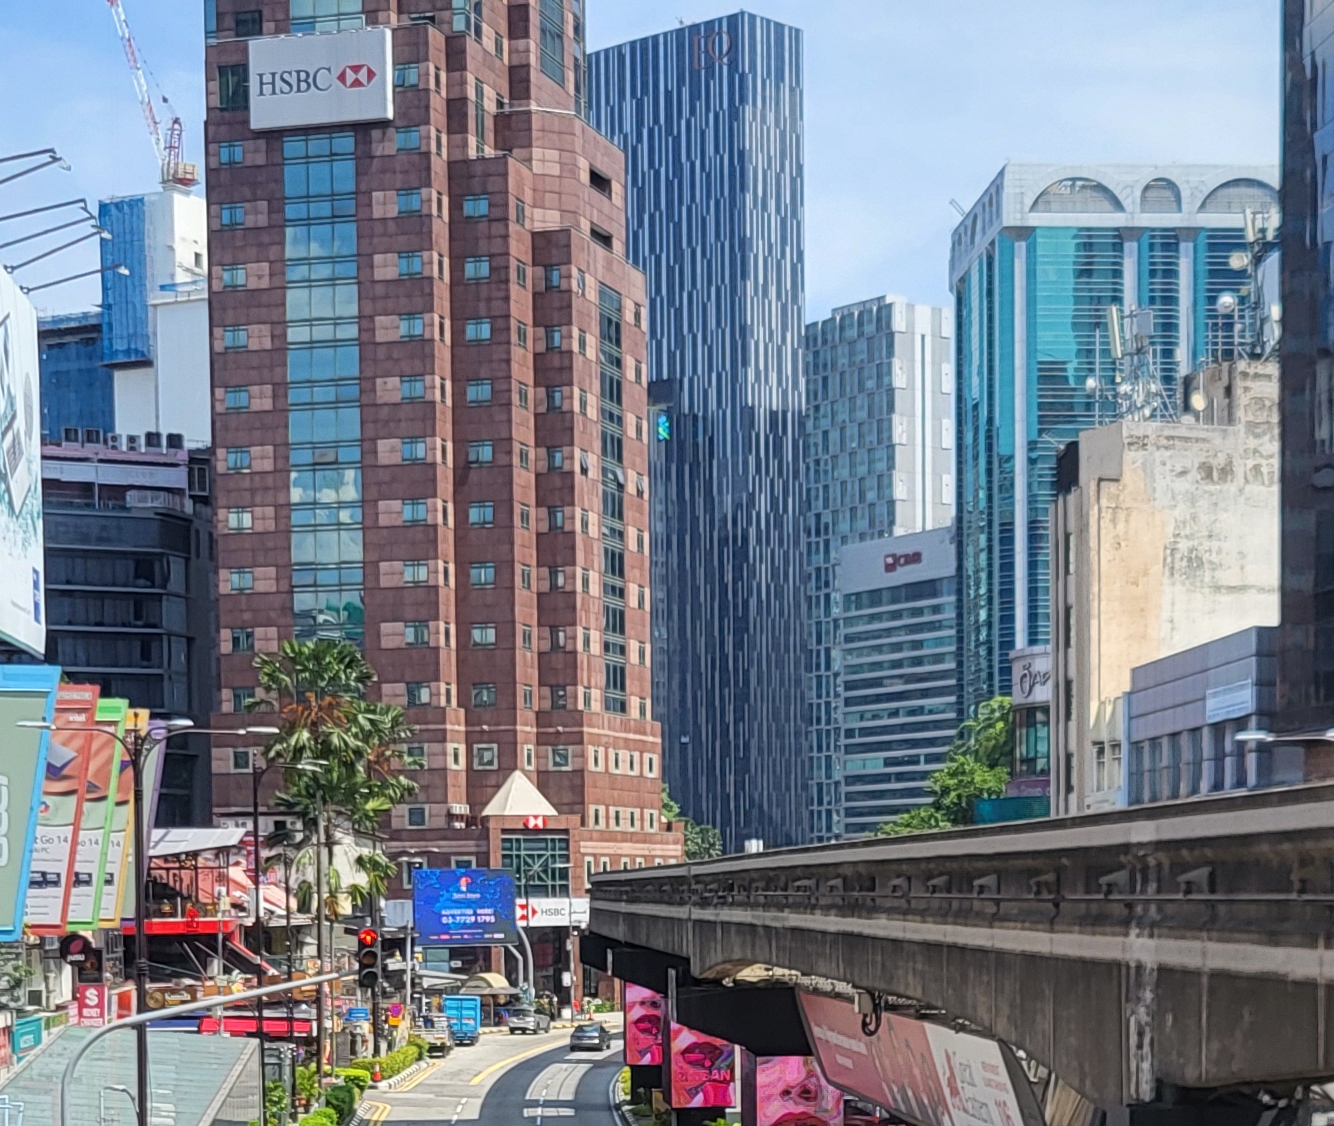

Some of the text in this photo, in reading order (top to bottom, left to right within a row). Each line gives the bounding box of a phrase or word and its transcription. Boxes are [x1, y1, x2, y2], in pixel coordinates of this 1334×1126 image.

[693, 30, 733, 70] EQ
[256, 67, 333, 97] HSBC
[40, 835, 54, 845] Go
[56, 835, 69, 845] 14
[88, 838, 100, 847] 14
[110, 841, 121, 849] 14
[541, 907, 566, 917] HSBC
